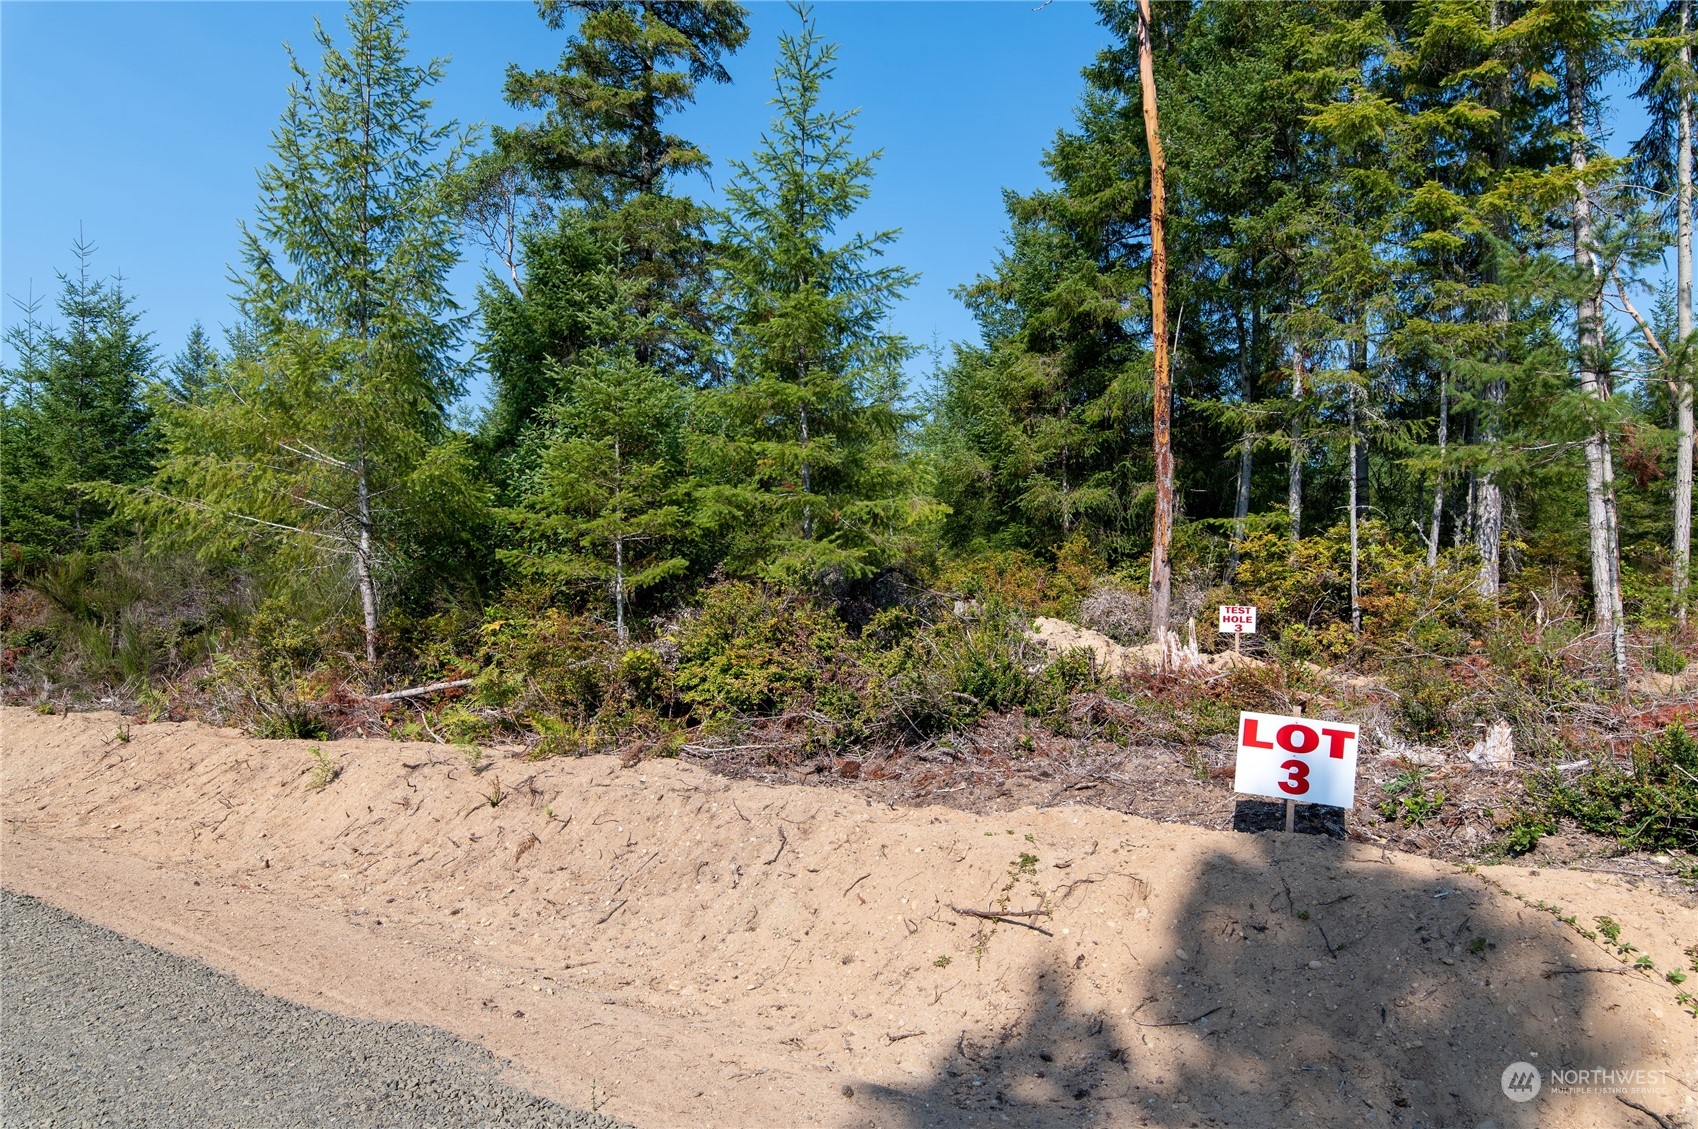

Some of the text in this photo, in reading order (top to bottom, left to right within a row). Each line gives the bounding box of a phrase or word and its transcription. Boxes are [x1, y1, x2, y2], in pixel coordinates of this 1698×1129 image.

[1234, 624, 1243, 632] 3
[1243, 718, 1355, 759] LOT
[1278, 760, 1310, 795] 3
